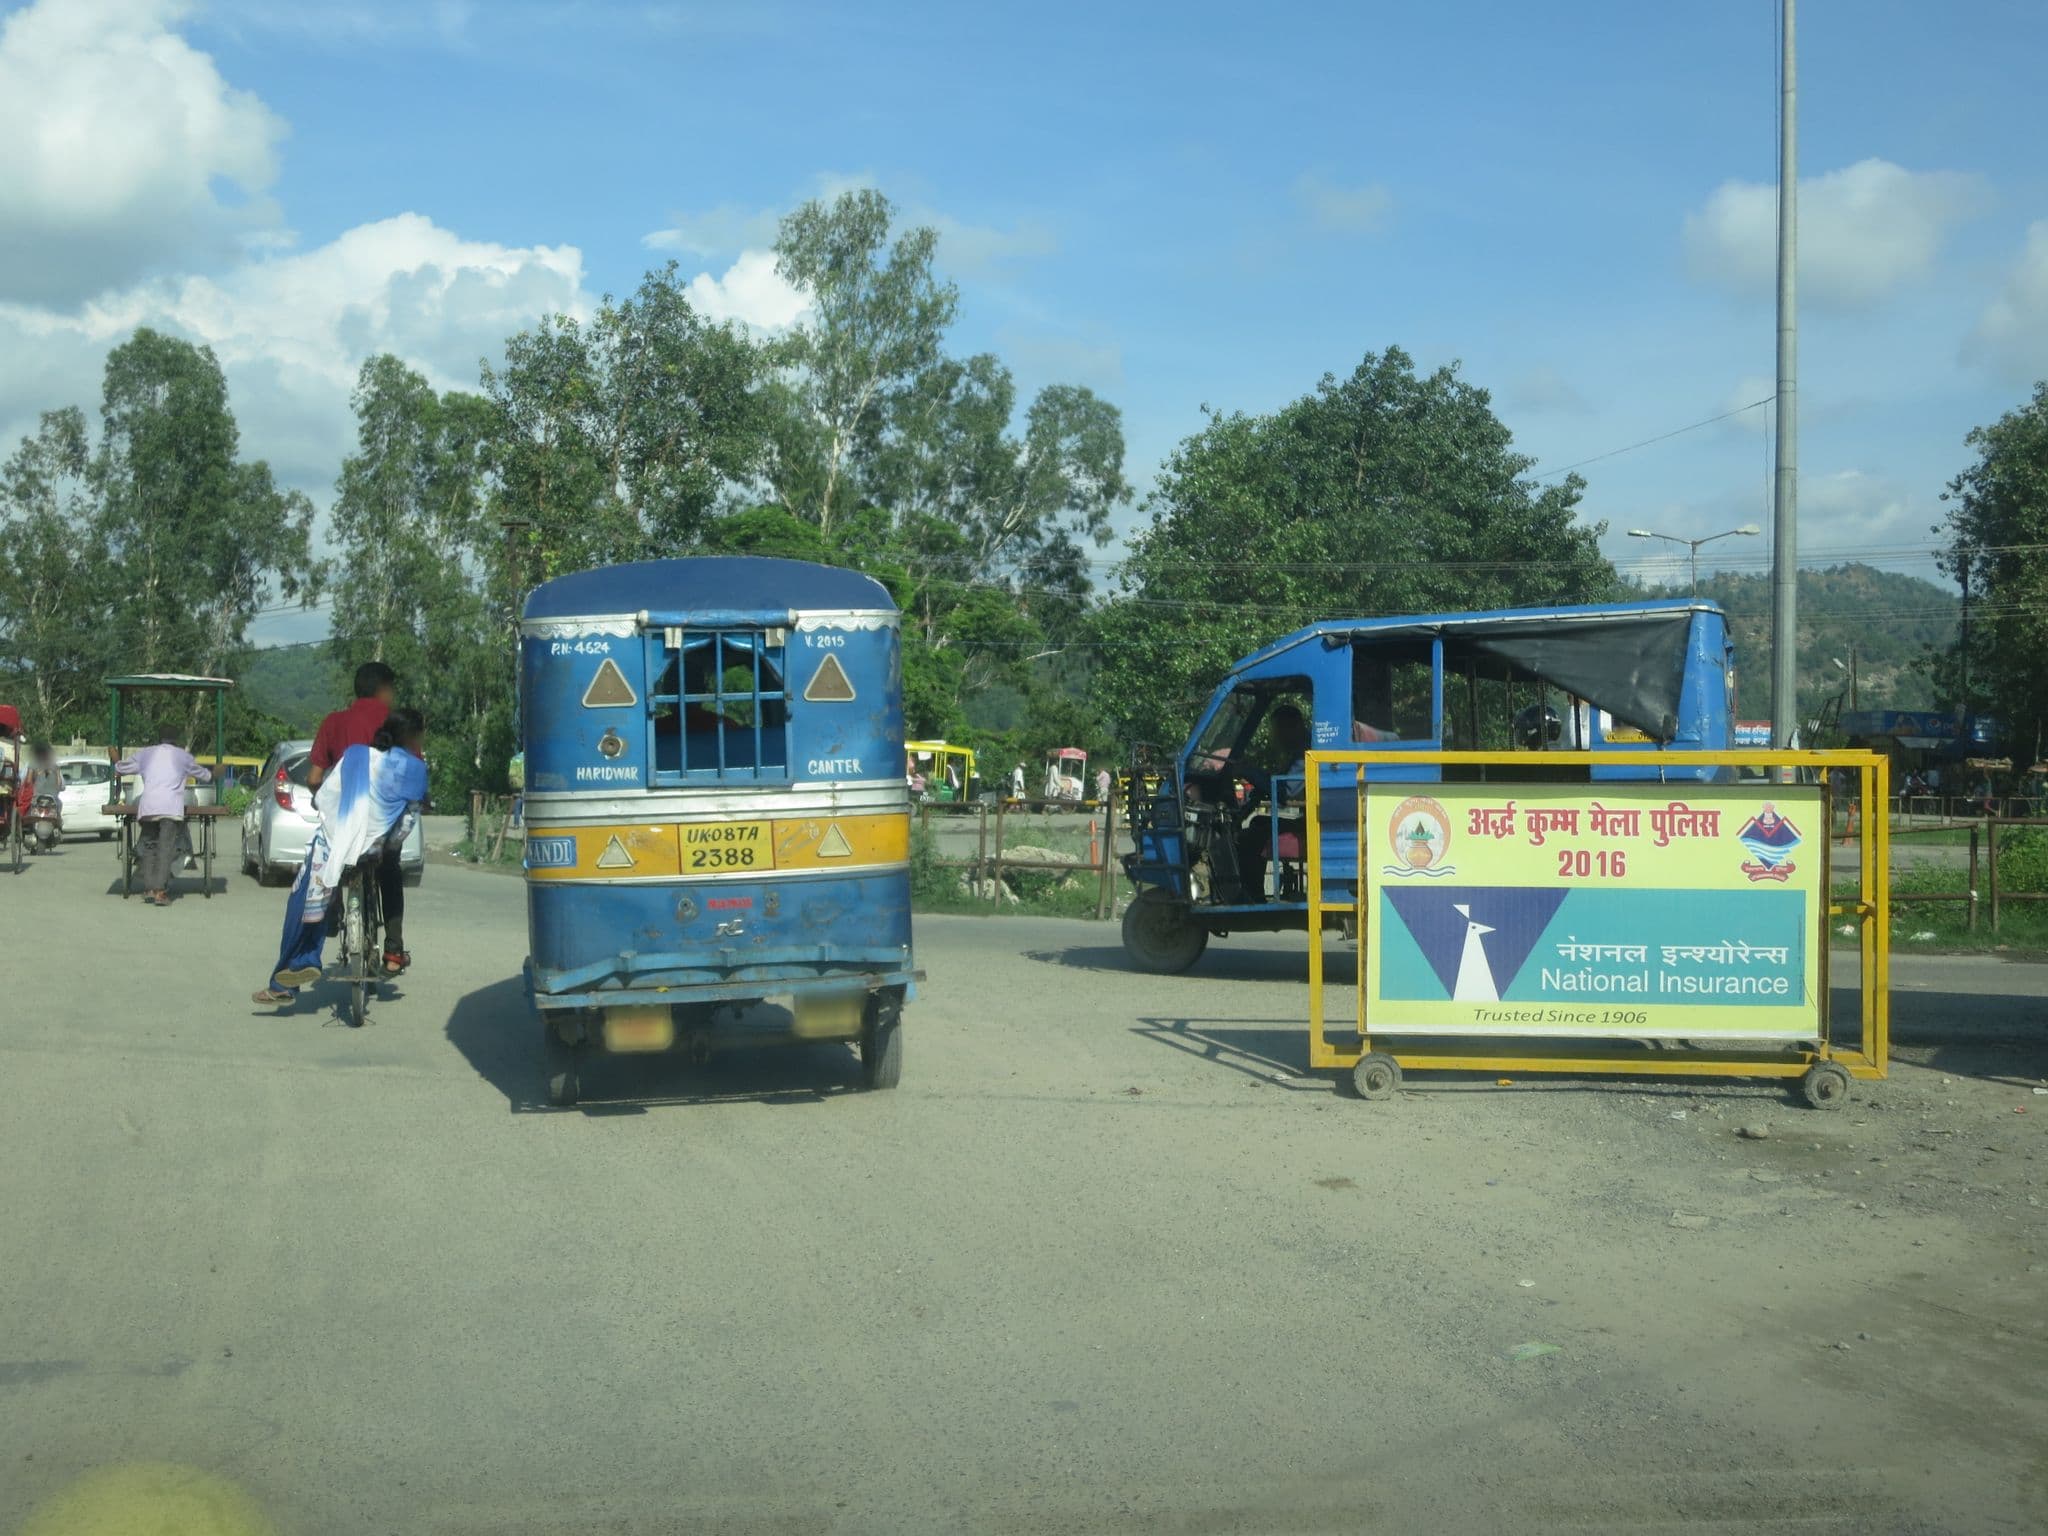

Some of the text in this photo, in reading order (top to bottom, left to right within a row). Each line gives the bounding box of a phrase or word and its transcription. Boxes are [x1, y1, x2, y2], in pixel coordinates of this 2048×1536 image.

[817, 635, 845, 648] 2015
[576, 766, 640, 782] HARIDWAR
[808, 759, 863, 775] CANTER
[1524, 808, 1581, 846] कुम्भ
[1588, 801, 1642, 837] मेला
[1649, 801, 1722, 847] पुलिस
[691, 847, 755, 868] 2388
[1558, 850, 1626, 877] 2016
[1541, 967, 1789, 994] National Insurance
[1473, 1009, 1648, 1024] Trusted Since 1906
